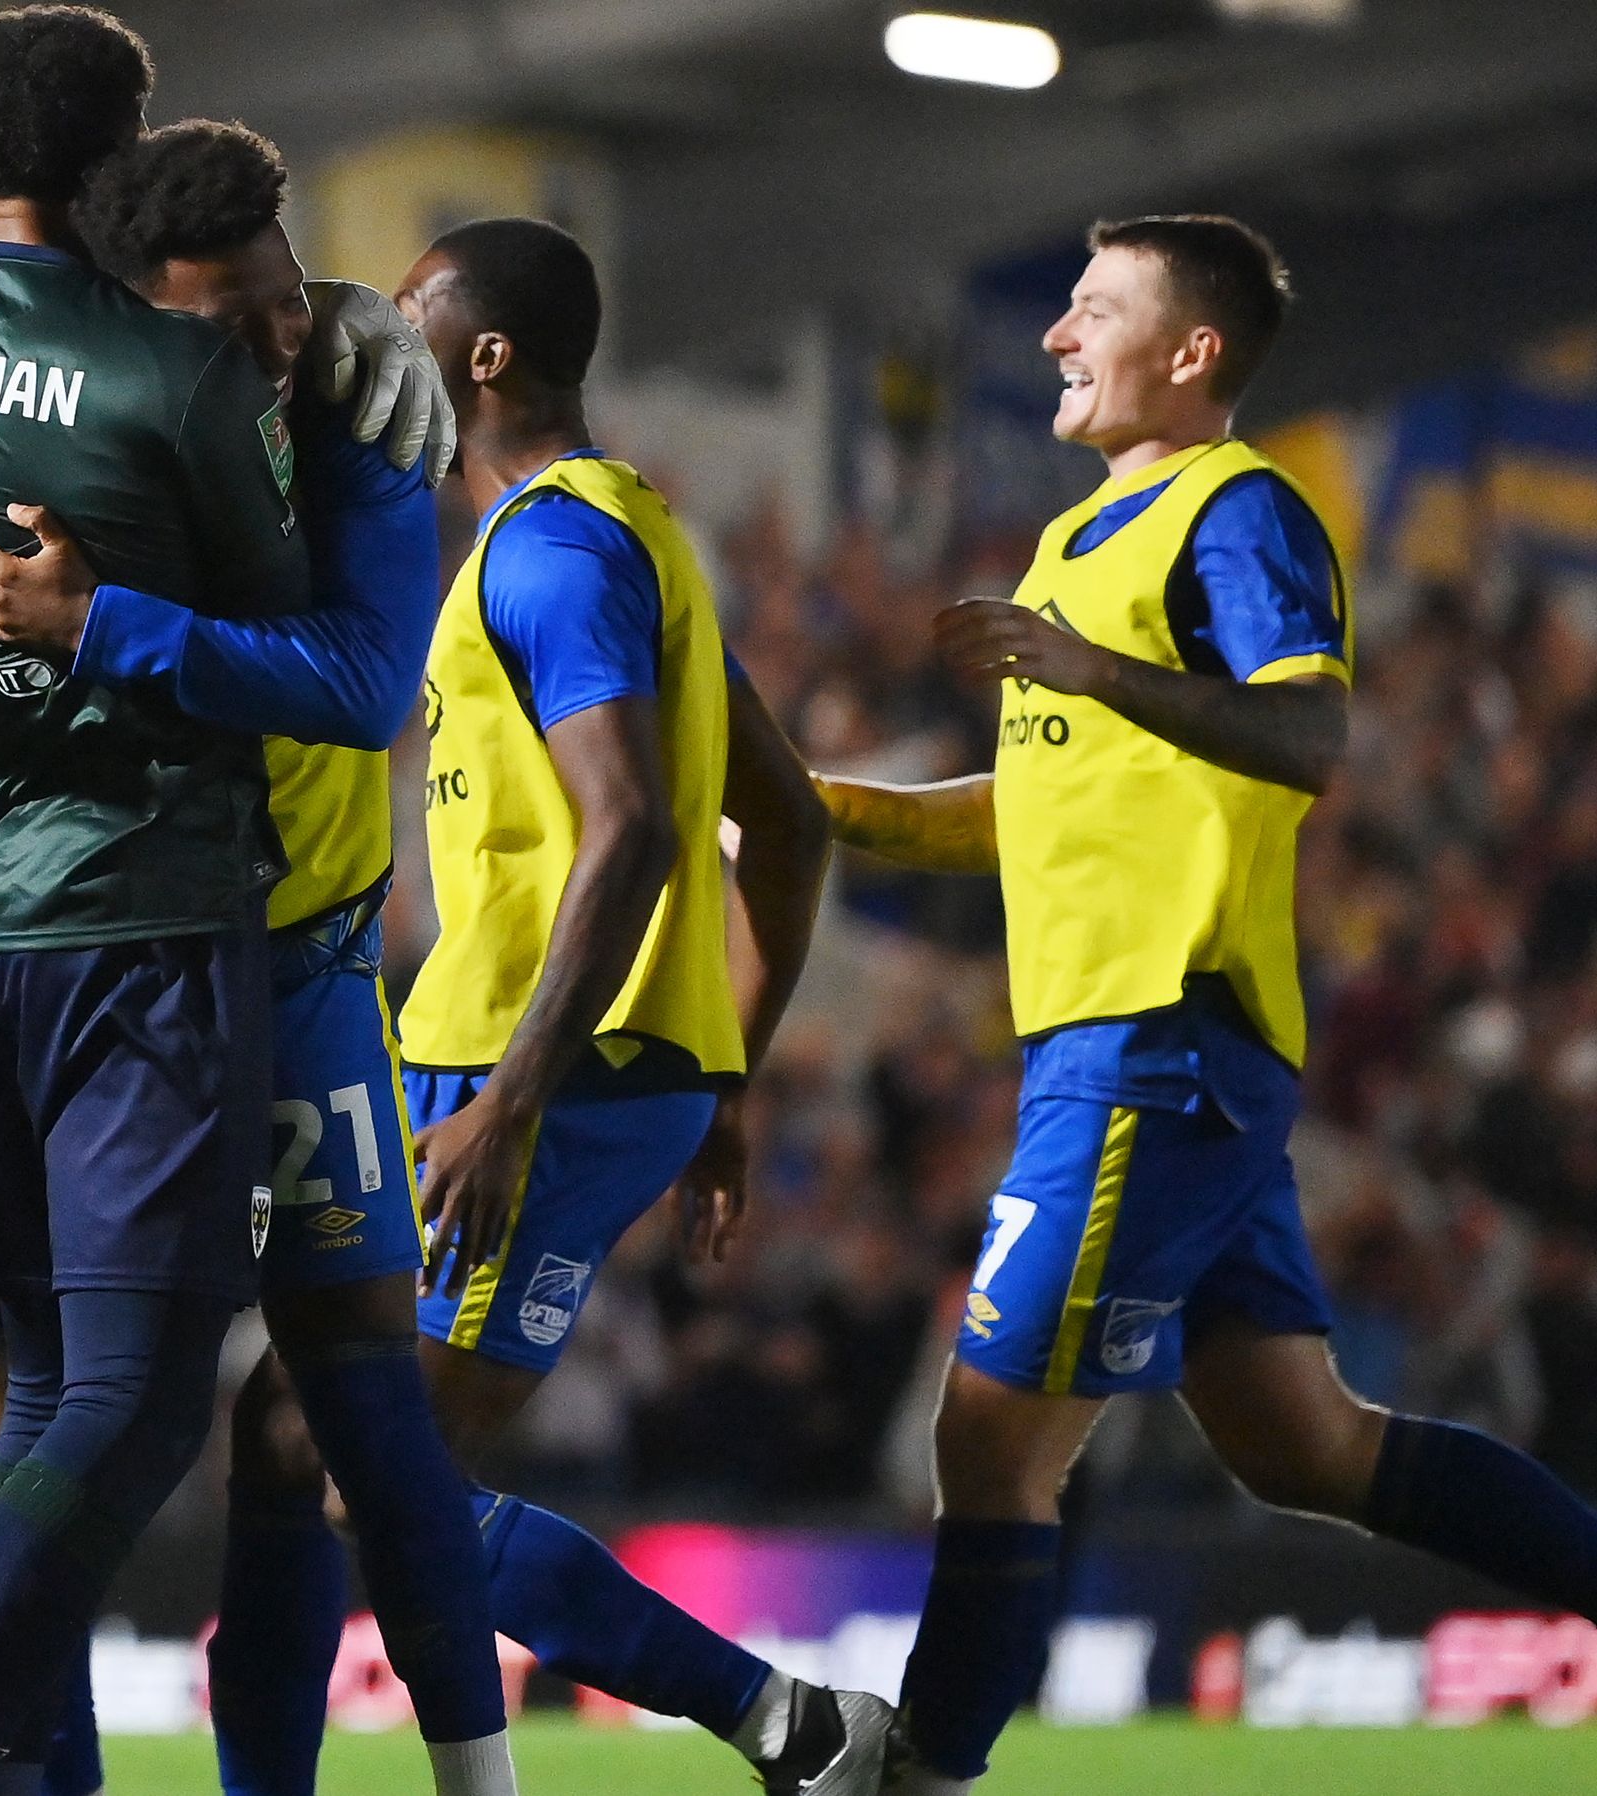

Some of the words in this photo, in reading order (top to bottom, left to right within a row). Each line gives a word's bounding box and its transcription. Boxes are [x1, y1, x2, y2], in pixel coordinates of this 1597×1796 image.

[272, 1082, 383, 1205] 21
[311, 1234, 364, 1250] umbro
[972, 1193, 1039, 1292] 7
